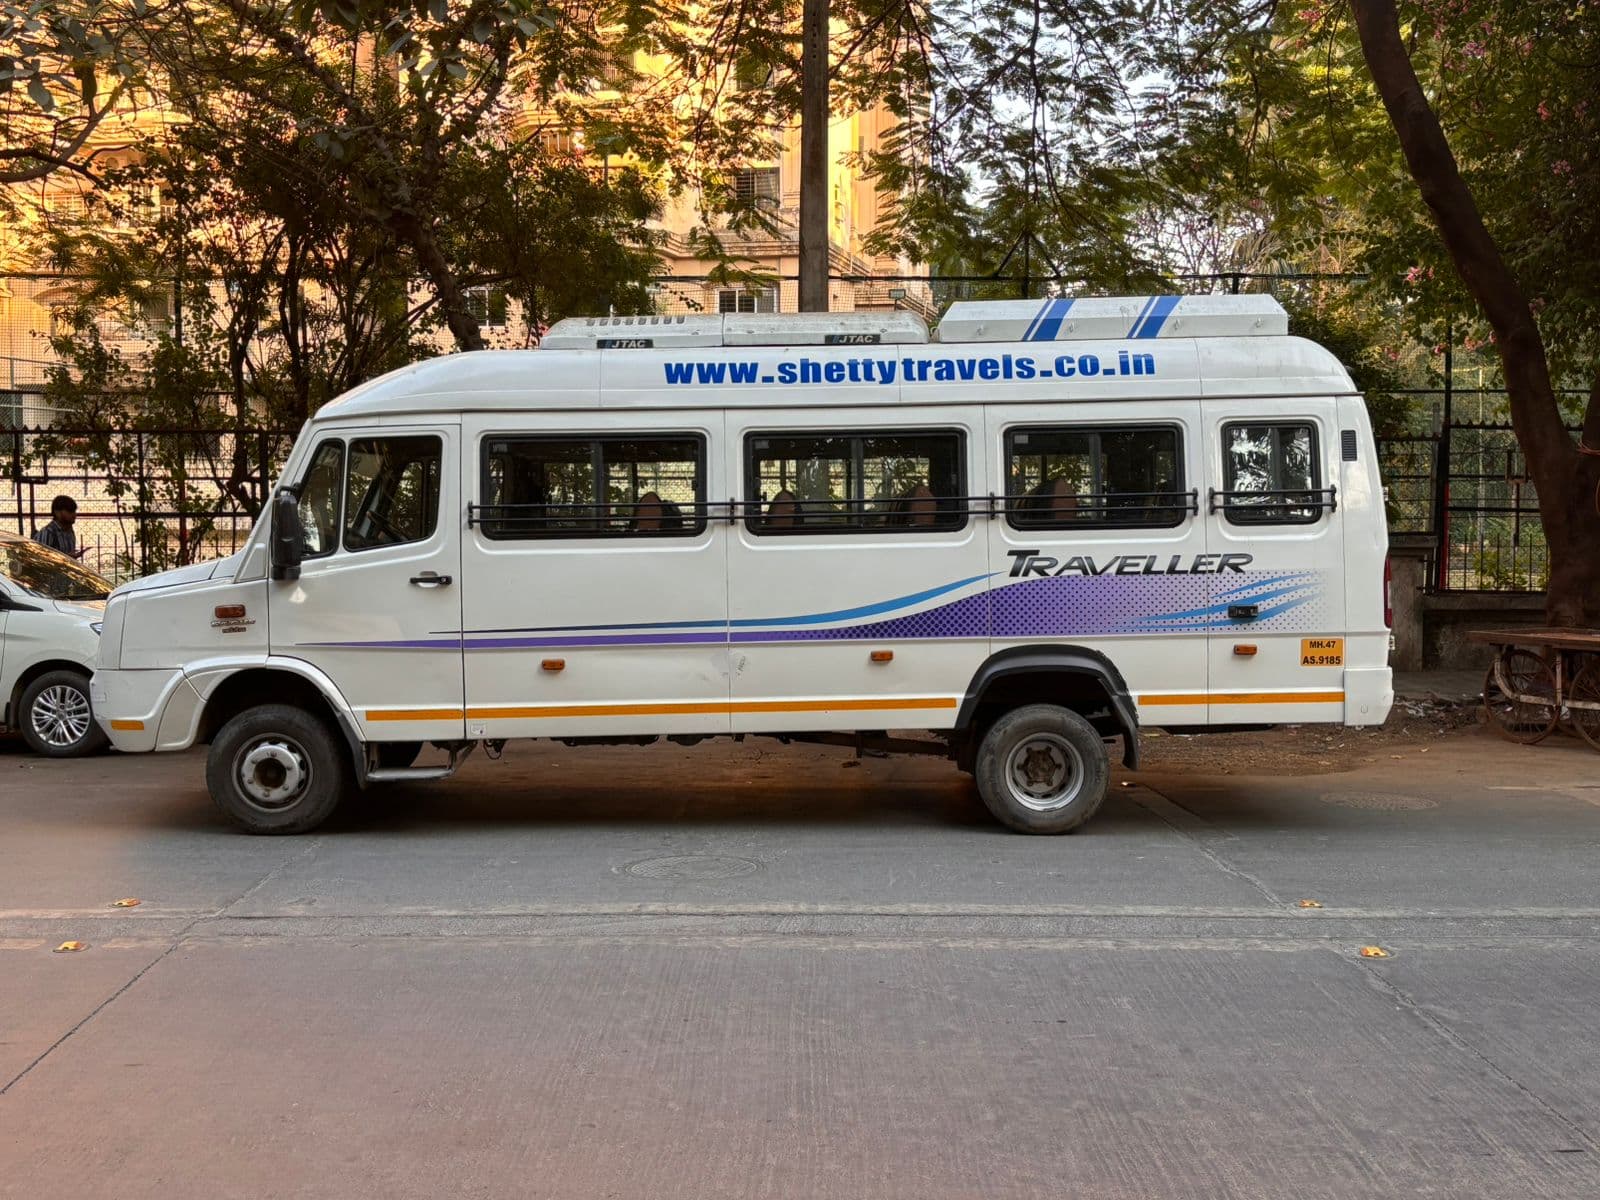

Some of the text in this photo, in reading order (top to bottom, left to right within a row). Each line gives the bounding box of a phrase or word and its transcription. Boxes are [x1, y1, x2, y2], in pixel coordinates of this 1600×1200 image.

[611, 340, 647, 348] JTAC
[838, 335, 874, 344] JTAC
[664, 350, 1155, 384] www.shettytravels.co.in
[1007, 549, 1253, 577] TRAVELLER
[1309, 640, 1336, 649] MH.47
[1302, 655, 1341, 665] AS.9185
